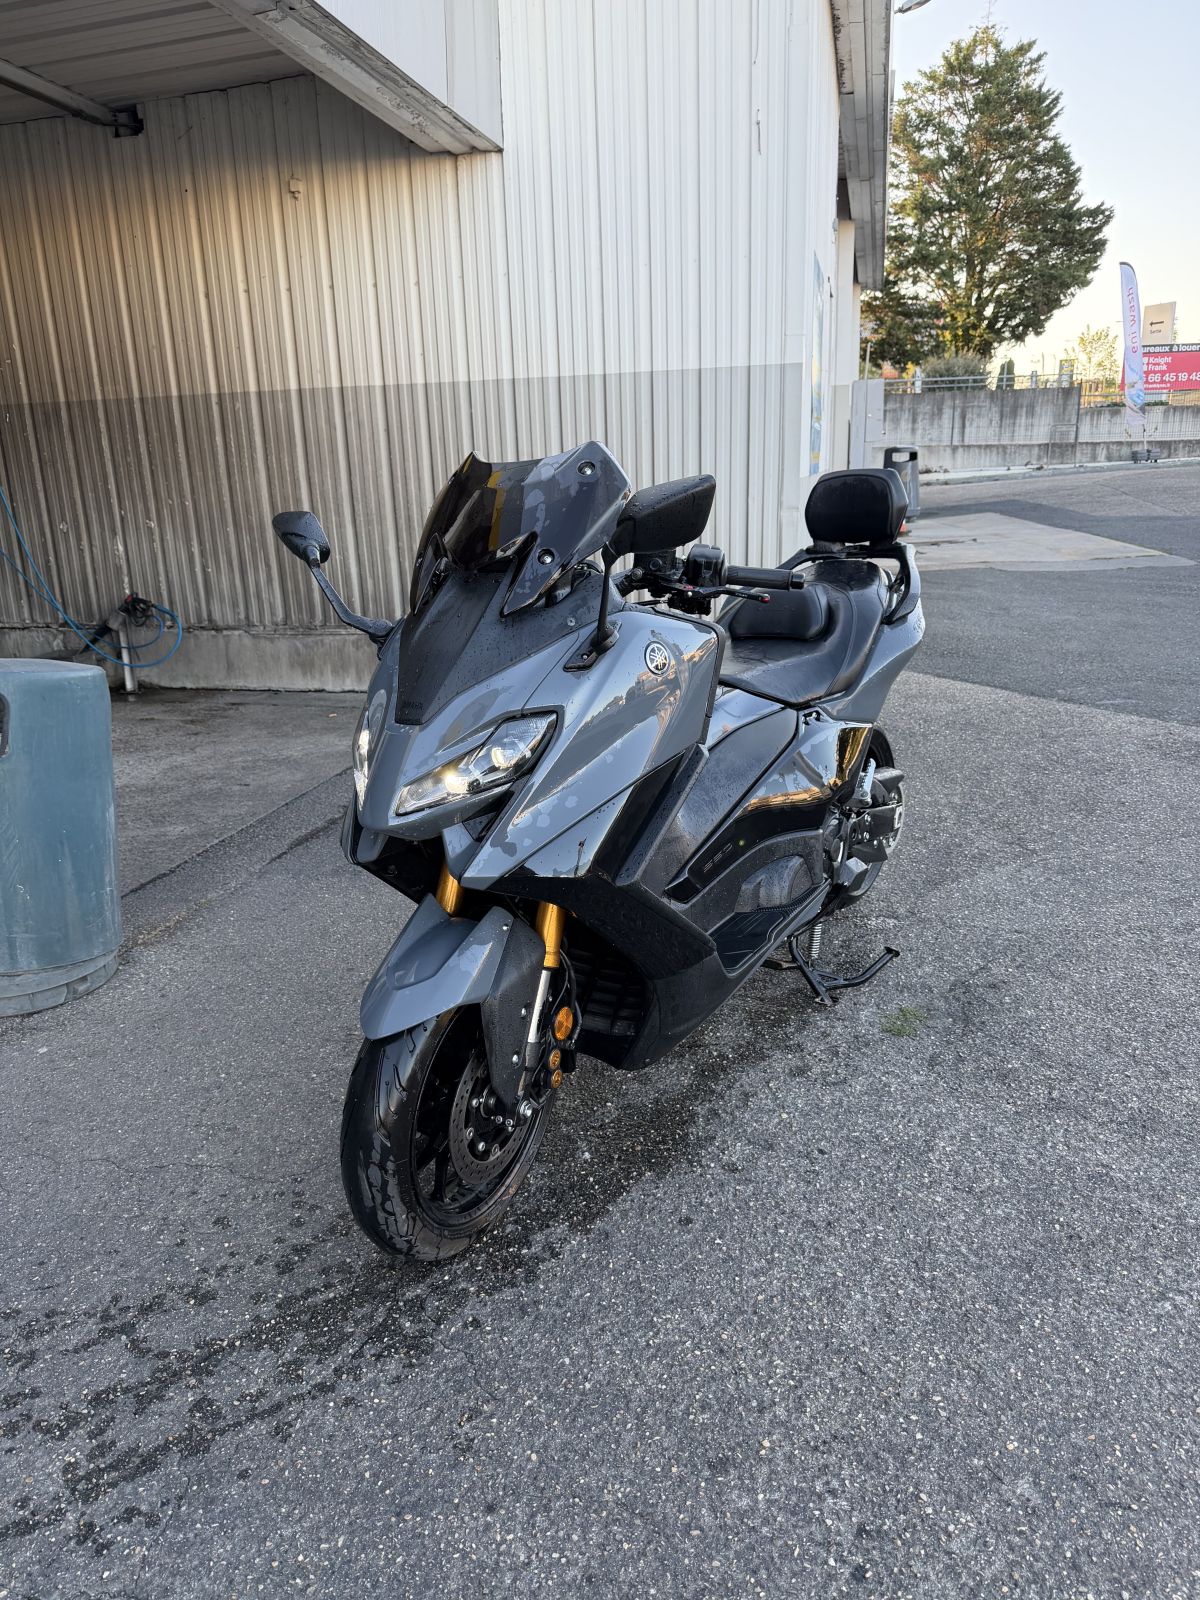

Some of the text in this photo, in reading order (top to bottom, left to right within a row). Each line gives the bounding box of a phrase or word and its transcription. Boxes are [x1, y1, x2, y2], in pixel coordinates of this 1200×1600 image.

[1127, 287, 1137, 327] wash
[1141, 345, 1170, 353] ureaux
[1179, 343, 1200, 352] louer
[1148, 356, 1172, 365] Knight
[1148, 363, 1168, 371] Frank
[1148, 373, 1161, 382] 66
[1162, 372, 1176, 382] 45
[1177, 372, 1188, 381] 19
